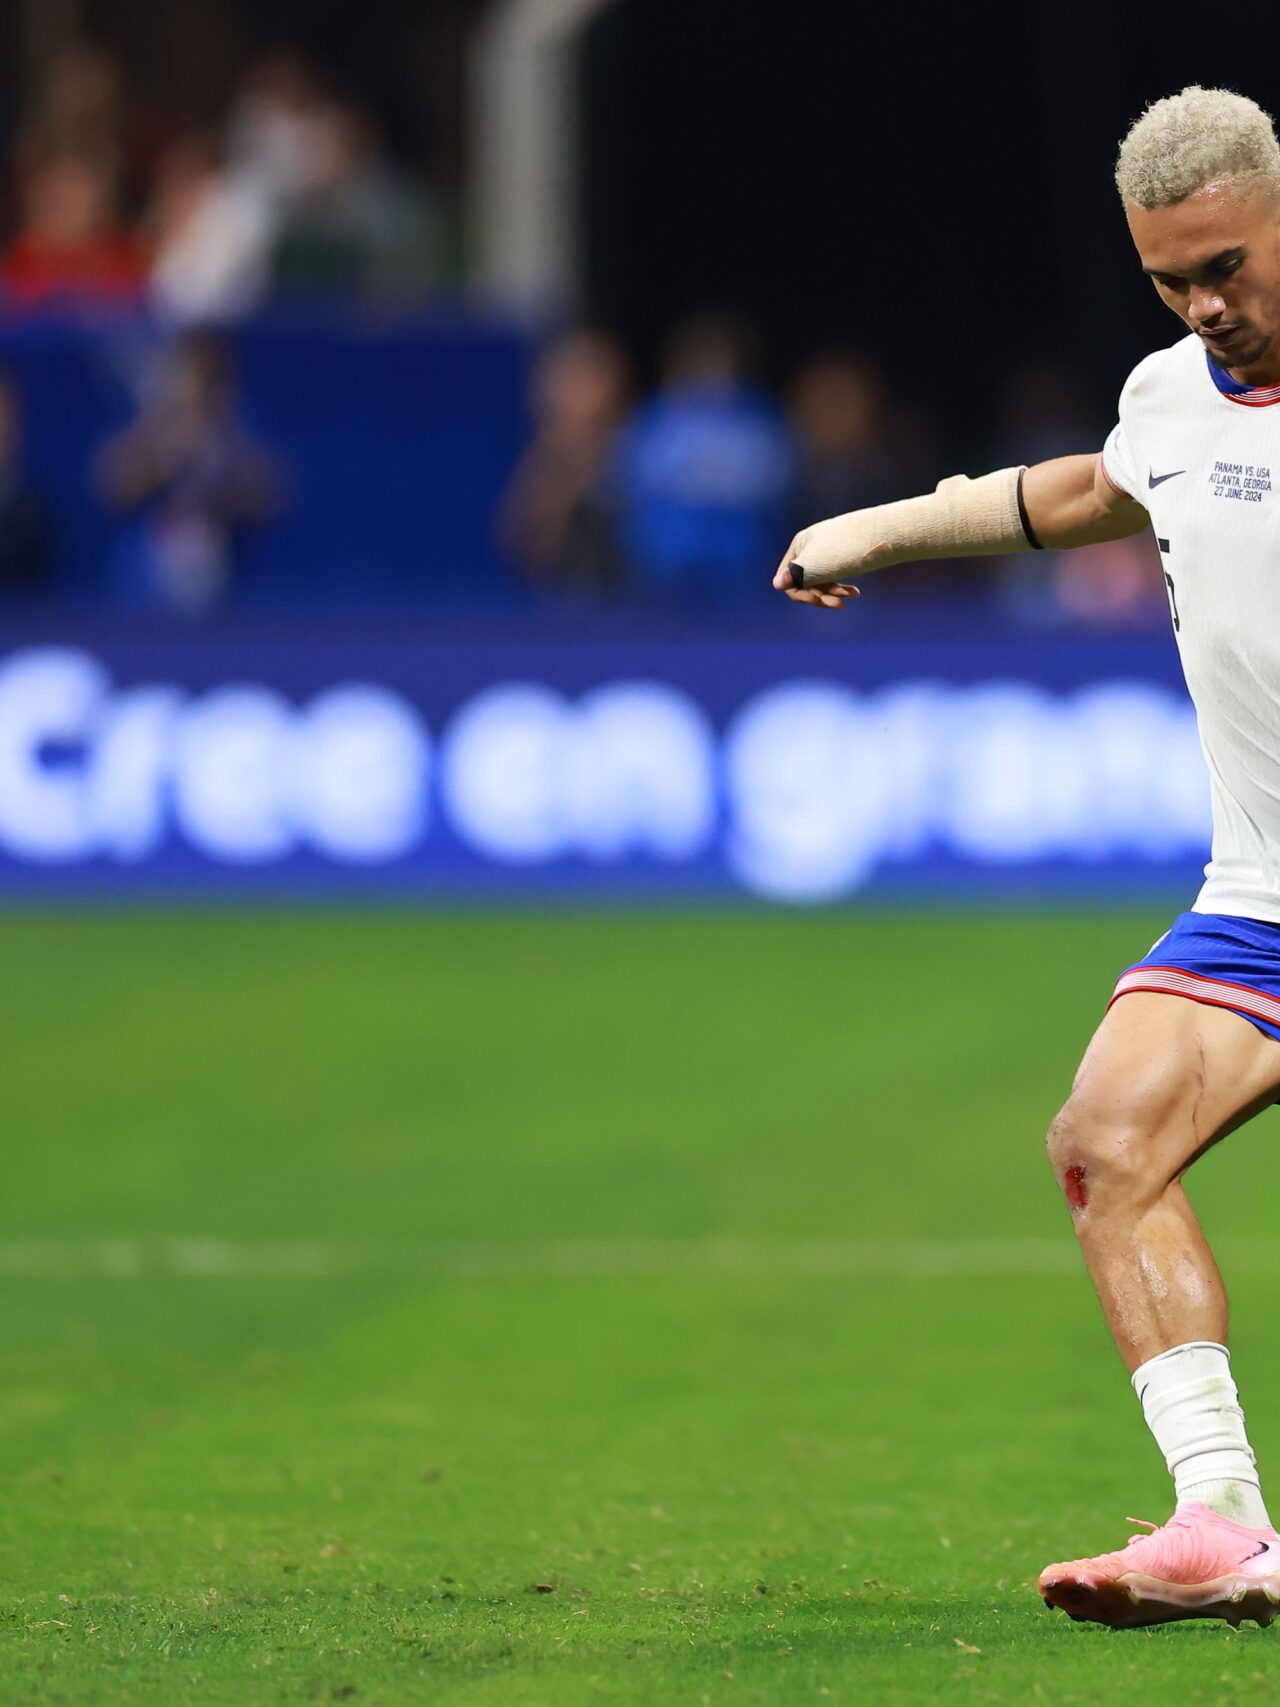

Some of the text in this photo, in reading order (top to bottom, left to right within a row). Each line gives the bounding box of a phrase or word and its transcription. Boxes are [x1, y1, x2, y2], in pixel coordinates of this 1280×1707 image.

[1214, 461, 1271, 479] PANAMA VS. USA
[1208, 473, 1272, 491] ATLANTA, GEORGIA
[1214, 485, 1262, 502] 27 JUNE 2024
